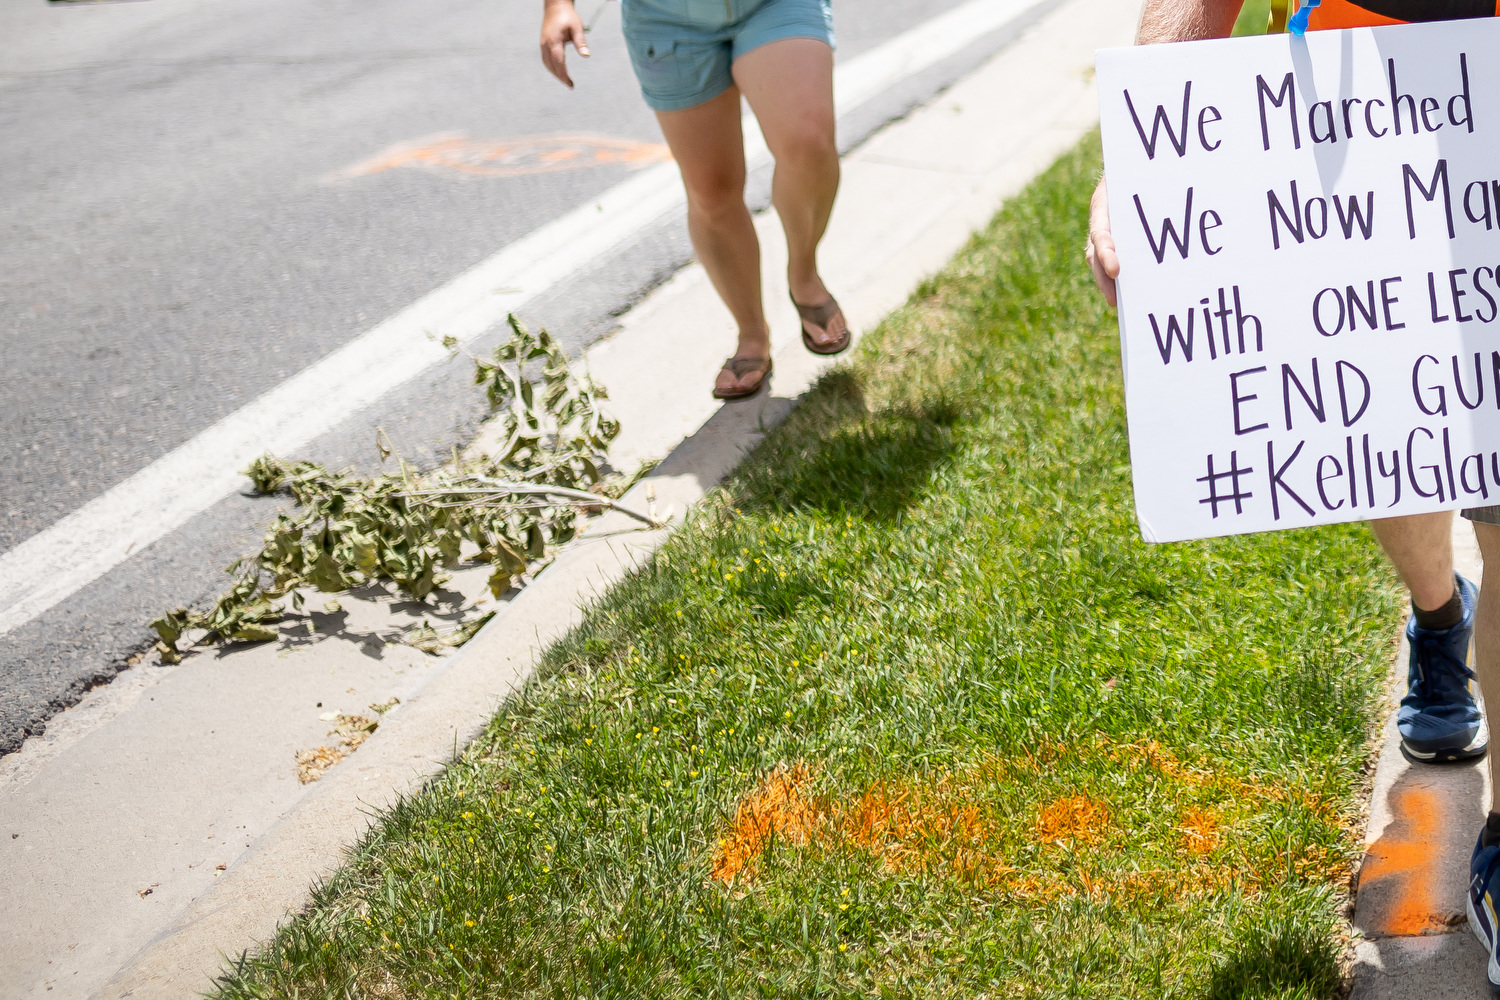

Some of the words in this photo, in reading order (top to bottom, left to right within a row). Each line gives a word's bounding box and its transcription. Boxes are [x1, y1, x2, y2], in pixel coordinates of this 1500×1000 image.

[1123, 80, 1223, 161] We
[1256, 52, 1475, 152] Marched
[1132, 186, 1223, 265] We
[1266, 179, 1374, 251] Now
[1312, 275, 1406, 337] ONE
[1228, 357, 1371, 436] END
